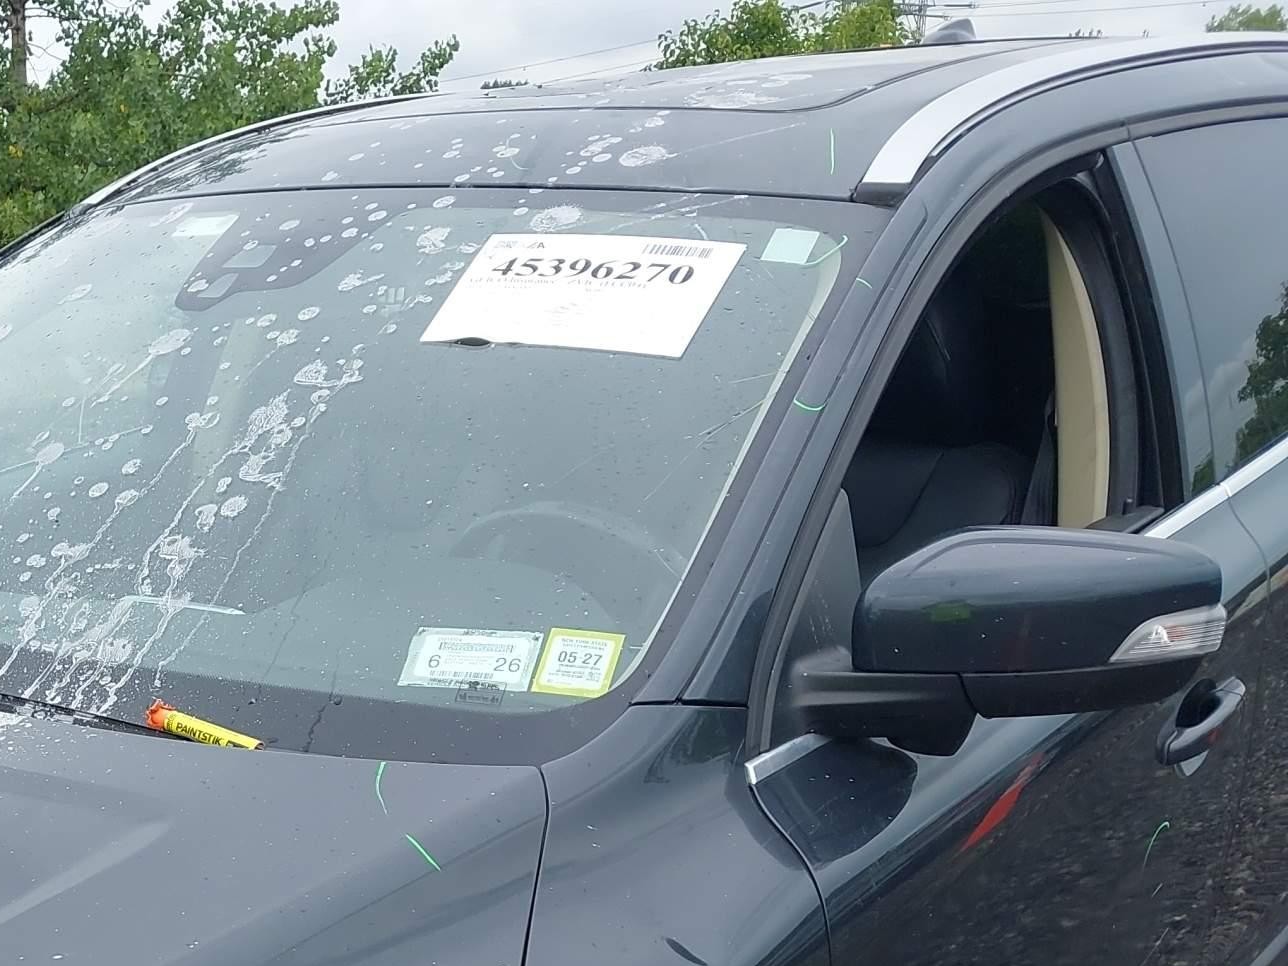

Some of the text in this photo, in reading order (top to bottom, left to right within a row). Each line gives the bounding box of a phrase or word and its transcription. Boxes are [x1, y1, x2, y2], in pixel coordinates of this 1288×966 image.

[491, 256, 695, 286] 45396270
[427, 654, 441, 669] 6
[493, 657, 522, 673] 26
[175, 722, 224, 746] PAINTSTIK
